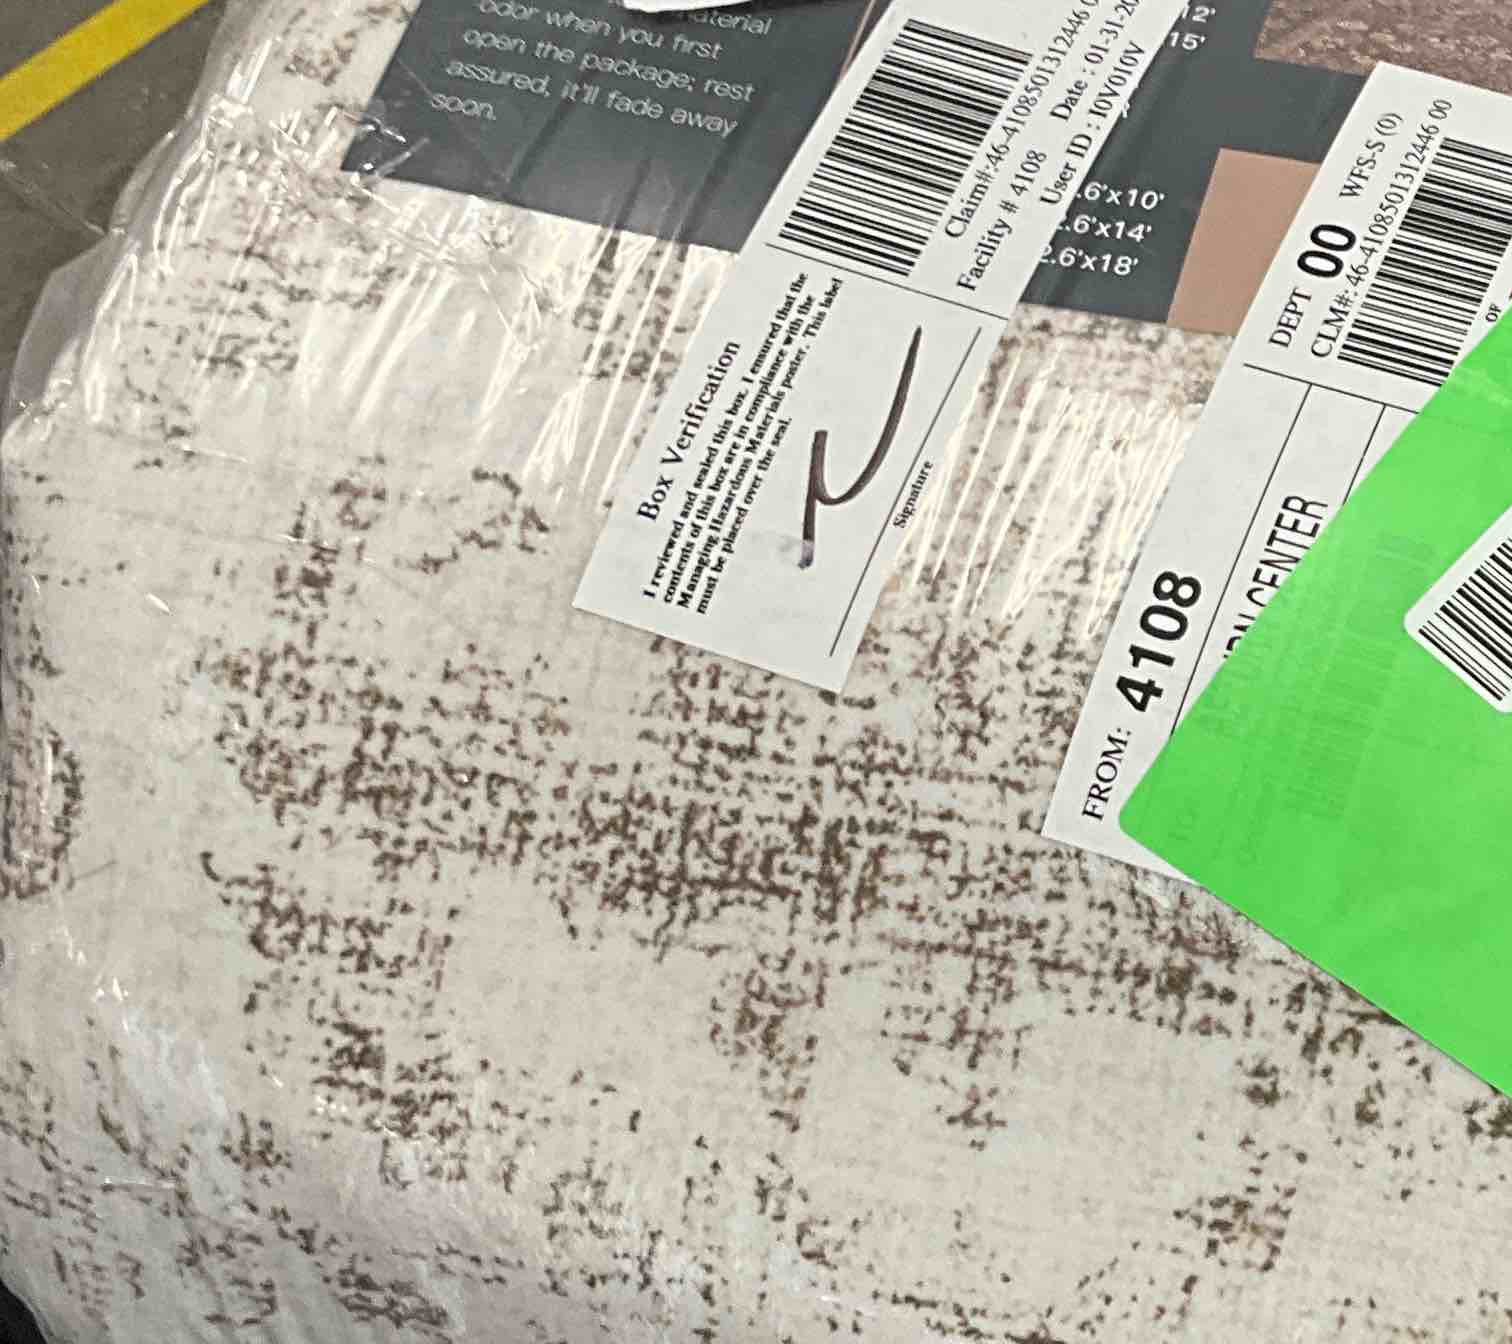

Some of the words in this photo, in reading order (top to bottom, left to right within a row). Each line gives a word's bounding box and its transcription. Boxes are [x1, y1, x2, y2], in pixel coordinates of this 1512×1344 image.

[430, 93, 497, 121] soon.
[446, 59, 551, 98] assured,
[606, 89, 665, 120] fade
[671, 107, 738, 139] away
[463, 29, 527, 54] open
[534, 40, 577, 64] the
[703, 78, 756, 103] rest
[546, 11, 612, 37] when
[617, 25, 665, 48] you
[672, 32, 724, 60] first
[956, 218, 1013, 291] Facility
[1000, 199, 1020, 215] #
[1010, 149, 1047, 198] 4108
[1050, 79, 1088, 122] Date
[1039, 161, 1077, 205] User
[1066, 133, 1093, 159] ID
[1269, 287, 1312, 348] DEPT
[1297, 223, 1357, 278] 00
[1339, 139, 1386, 199] WFS-S
[1377, 112, 1403, 137] (0)
[636, 475, 674, 521] Box
[660, 342, 741, 465] Verification
[650, 520, 684, 594] reviewed
[680, 490, 698, 524] and
[693, 449, 720, 491] sealed
[712, 418, 734, 449] this
[725, 389, 749, 416] box.
[741, 375, 754, 385] I
[749, 321, 782, 375] ensured
[775, 294, 797, 321] that
[791, 272, 808, 294] the
[663, 540, 696, 604] contents
[691, 519, 704, 540] of
[699, 492, 717, 522] this
[709, 466, 730, 494] box
[725, 442, 742, 468] are
[734, 423, 750, 439] in
[745, 348, 788, 423] compliance
[783, 317, 805, 346] with
[799, 294, 816, 317] the
[676, 533, 720, 609] Managing
[709, 457, 753, 533] Hazardous
[744, 390, 786, 454] Materials
[802, 310, 827, 338] This
[819, 277, 844, 309] label
[696, 573, 720, 615] must
[711, 556, 728, 575] be
[721, 506, 750, 556] placed
[744, 473, 763, 506] over
[756, 452, 774, 475] the
[771, 417, 793, 450] seal.
[892, 460, 934, 529] Signature
[1246, 495, 1329, 607] CENTER
[1082, 727, 1132, 821] FROM:
[1116, 571, 1202, 713] 4108
